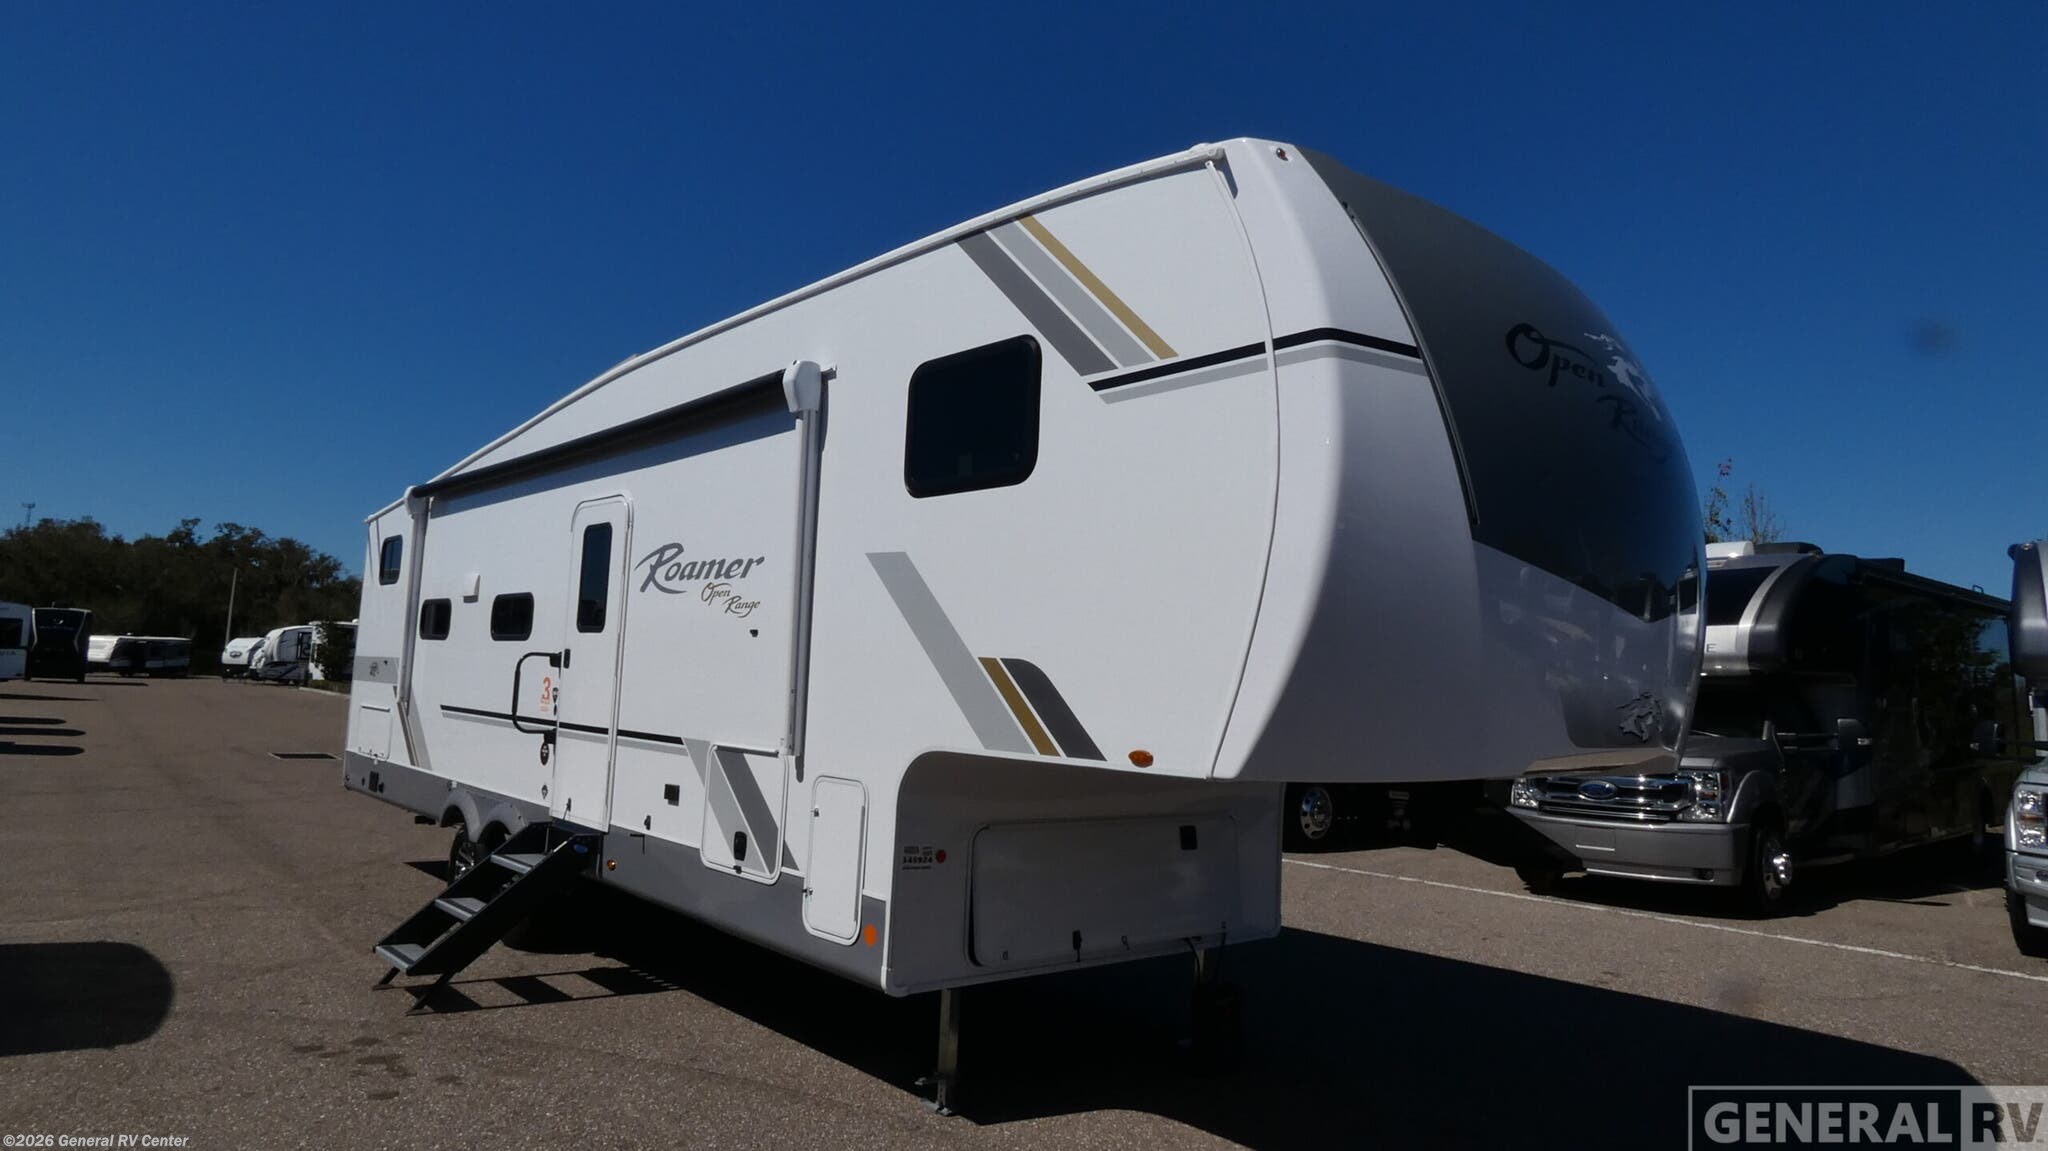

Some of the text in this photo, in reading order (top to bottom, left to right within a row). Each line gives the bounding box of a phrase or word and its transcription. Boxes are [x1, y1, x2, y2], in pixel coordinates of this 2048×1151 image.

[1505, 322, 1607, 388] Open
[634, 542, 765, 594] Roamer
[701, 582, 732, 606] Open
[722, 595, 761, 618] Range
